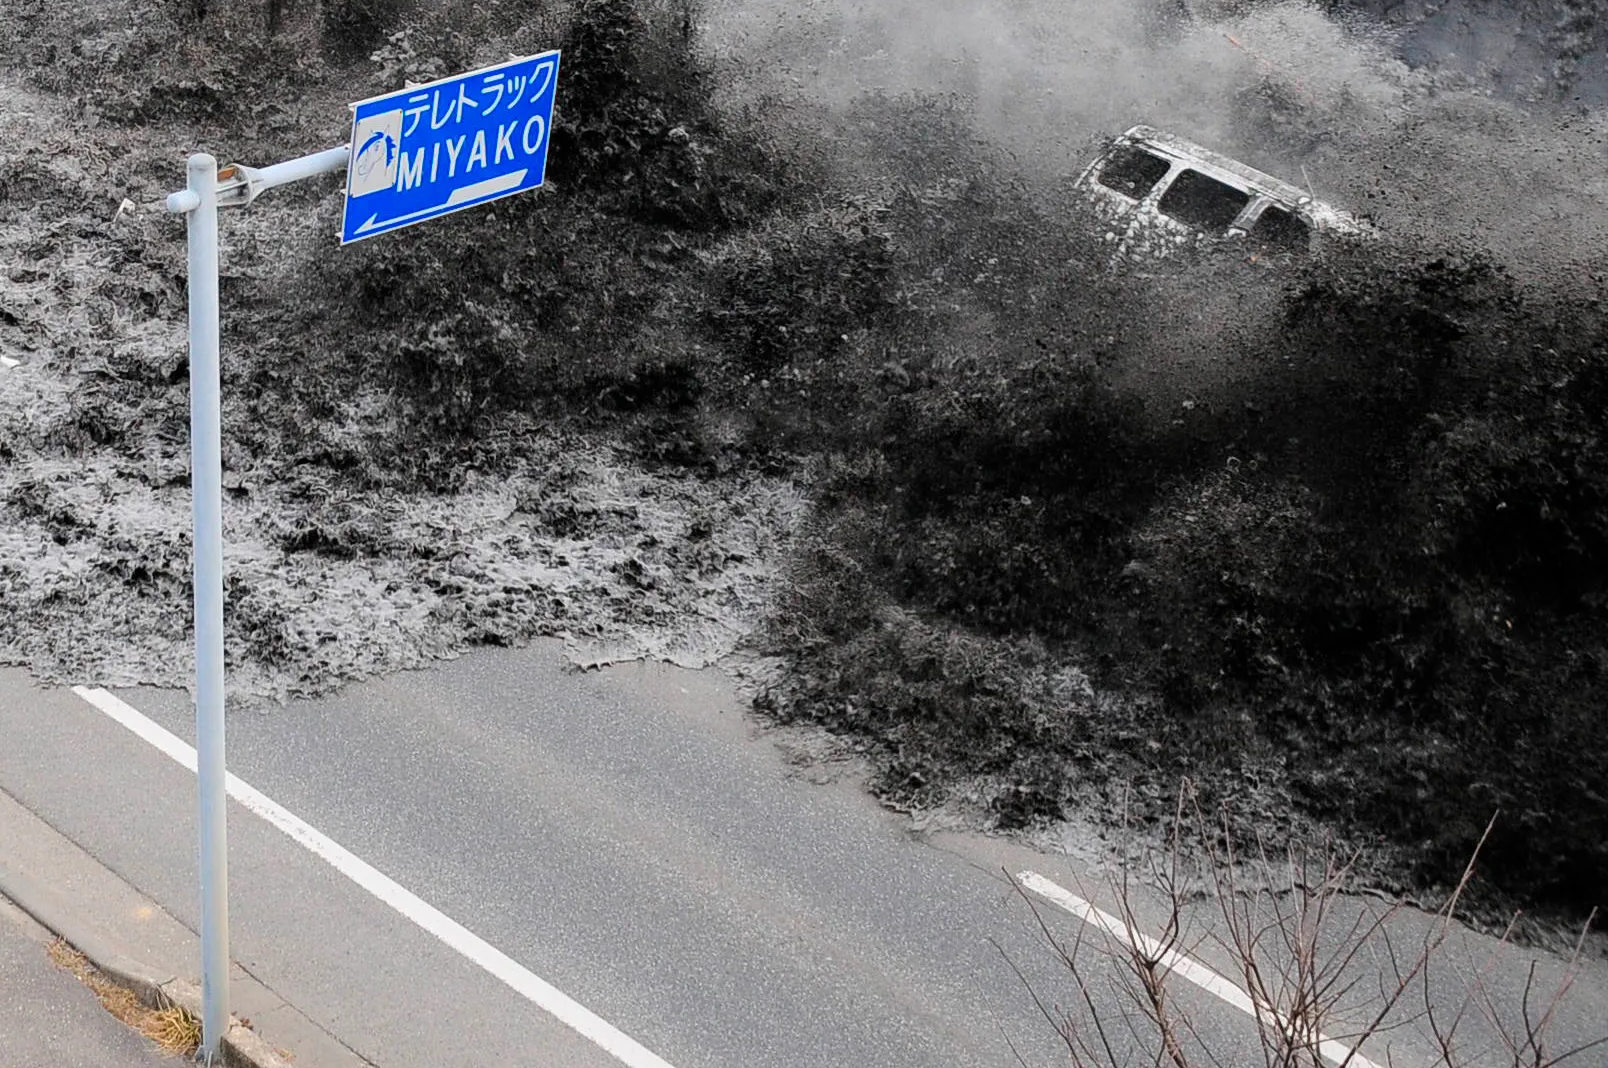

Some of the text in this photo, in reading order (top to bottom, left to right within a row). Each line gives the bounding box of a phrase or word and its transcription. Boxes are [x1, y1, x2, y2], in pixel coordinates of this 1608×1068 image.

[404, 61, 554, 138] テレトラック
[396, 115, 545, 193] MIYAKO
